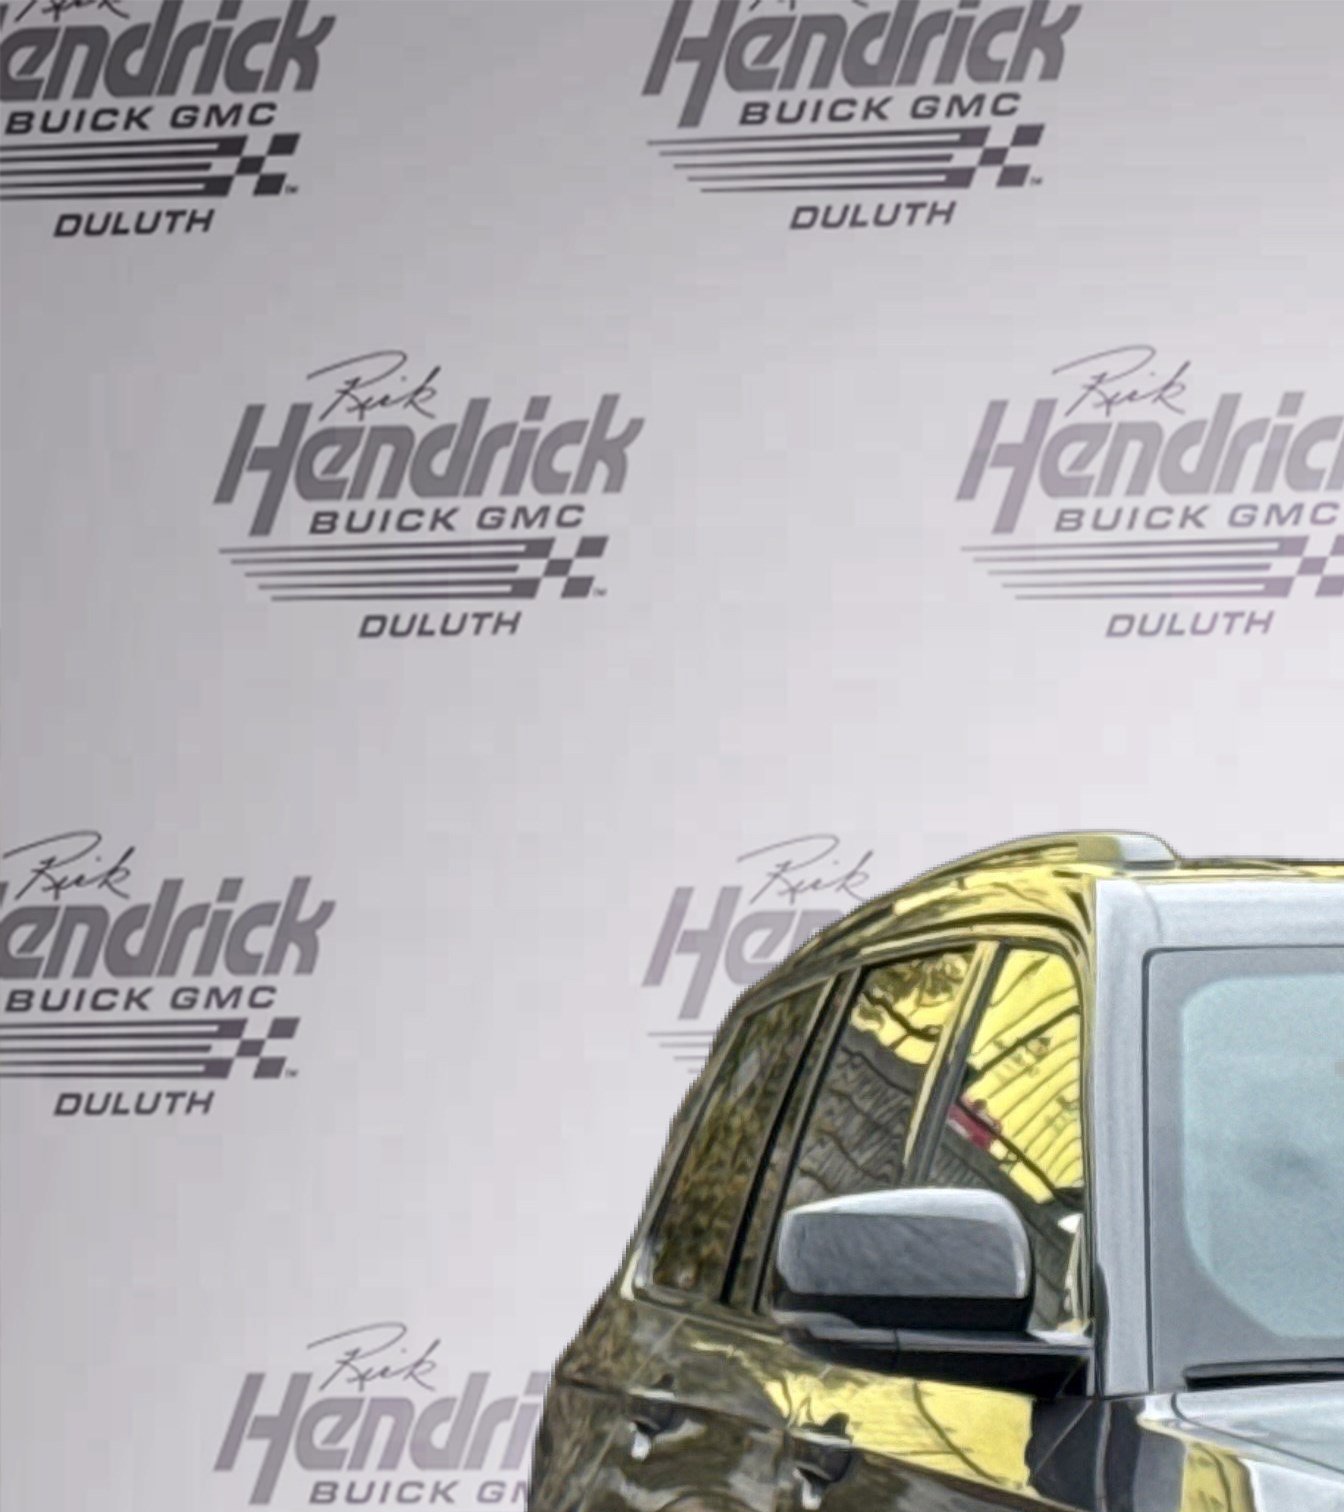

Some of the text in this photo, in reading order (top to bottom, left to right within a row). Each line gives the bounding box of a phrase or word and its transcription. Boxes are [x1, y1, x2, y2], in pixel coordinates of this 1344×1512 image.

[0, 0, 337, 102] endrick
[641, 0, 1083, 129] Hendrick
[5, 101, 278, 135] BUICK GMC
[738, 91, 1022, 126] BUICK GMC
[52, 208, 216, 238] DULUTH
[788, 200, 958, 231] DULUTH
[213, 393, 646, 538] Hendrick
[308, 503, 586, 535] BUICK GMC
[1054, 501, 1340, 532] BUICK GMC
[357, 610, 522, 639] DULUTH
[1105, 610, 1275, 638] DULUTH
[0, 875, 337, 980] endrick
[5, 985, 278, 1013] BUICK GMC
[53, 1090, 216, 1117] DULUTH
[213, 1372, 551, 1505] Hendri
[308, 1481, 460, 1505] BUICK
